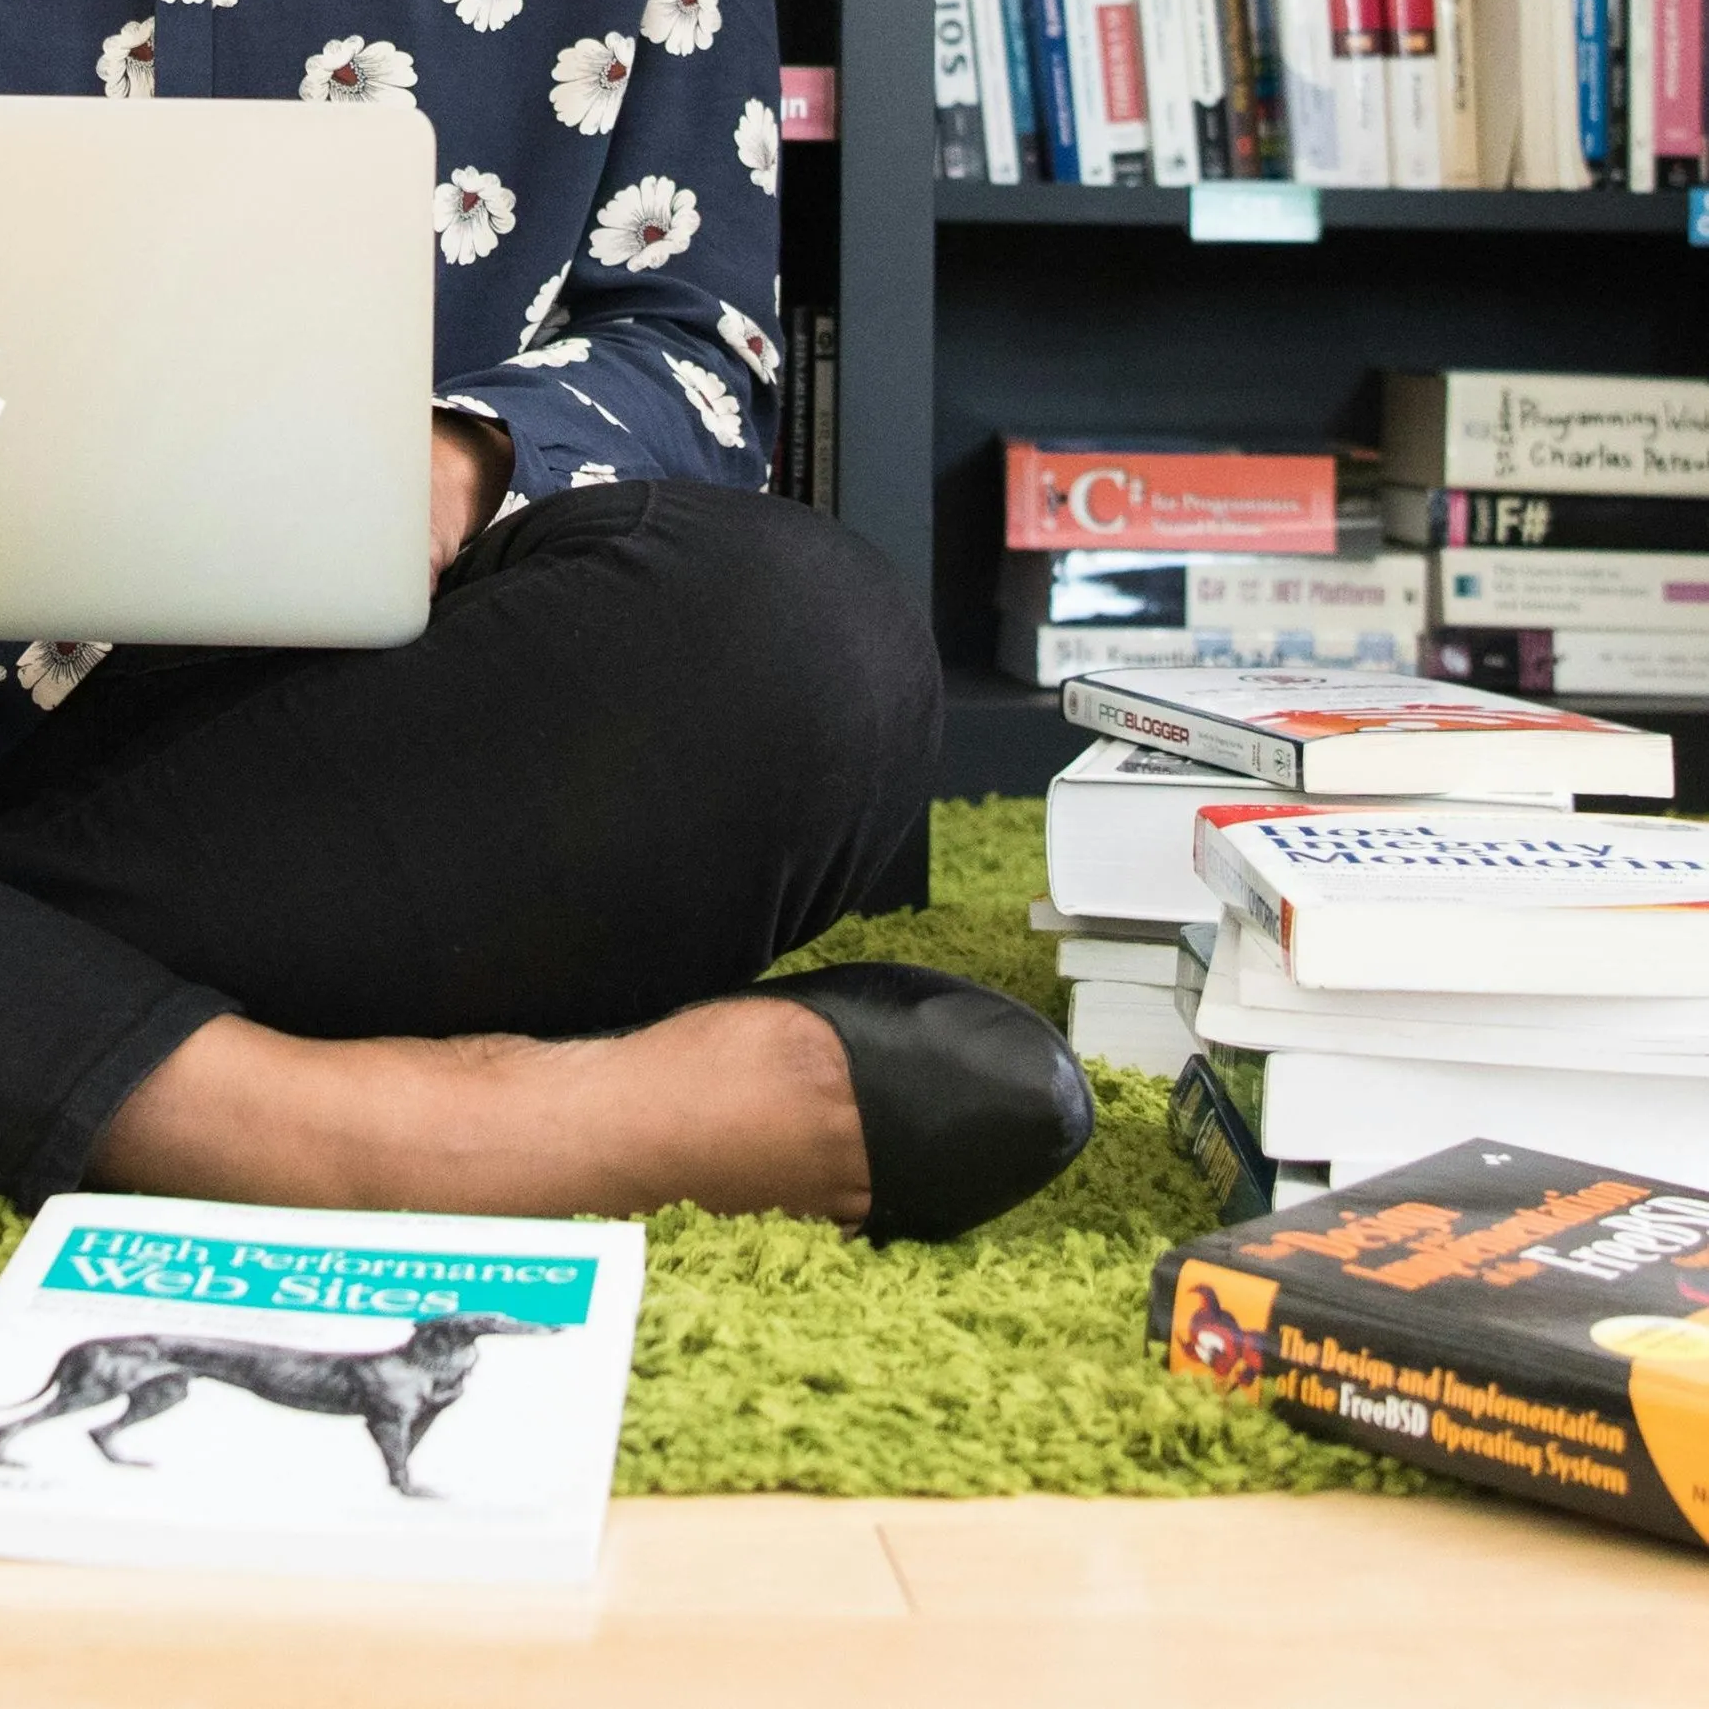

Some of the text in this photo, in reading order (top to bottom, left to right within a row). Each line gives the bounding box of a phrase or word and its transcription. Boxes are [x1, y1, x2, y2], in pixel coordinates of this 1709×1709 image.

[1518, 397, 1658, 441] Programming
[1529, 443, 1633, 469] Charles
[1494, 496, 1553, 543] F#
[1097, 701, 1190, 748] PROBLOGGER
[1256, 824, 1447, 837] Host
[1258, 836, 1615, 859] Integrity
[75, 1229, 578, 1286] High Performance
[69, 1254, 460, 1315] Web Sites
[1279, 1324, 1628, 1456] The Design and Implementation
[1275, 1370, 1629, 1495] of the FreeBSD Operating System
